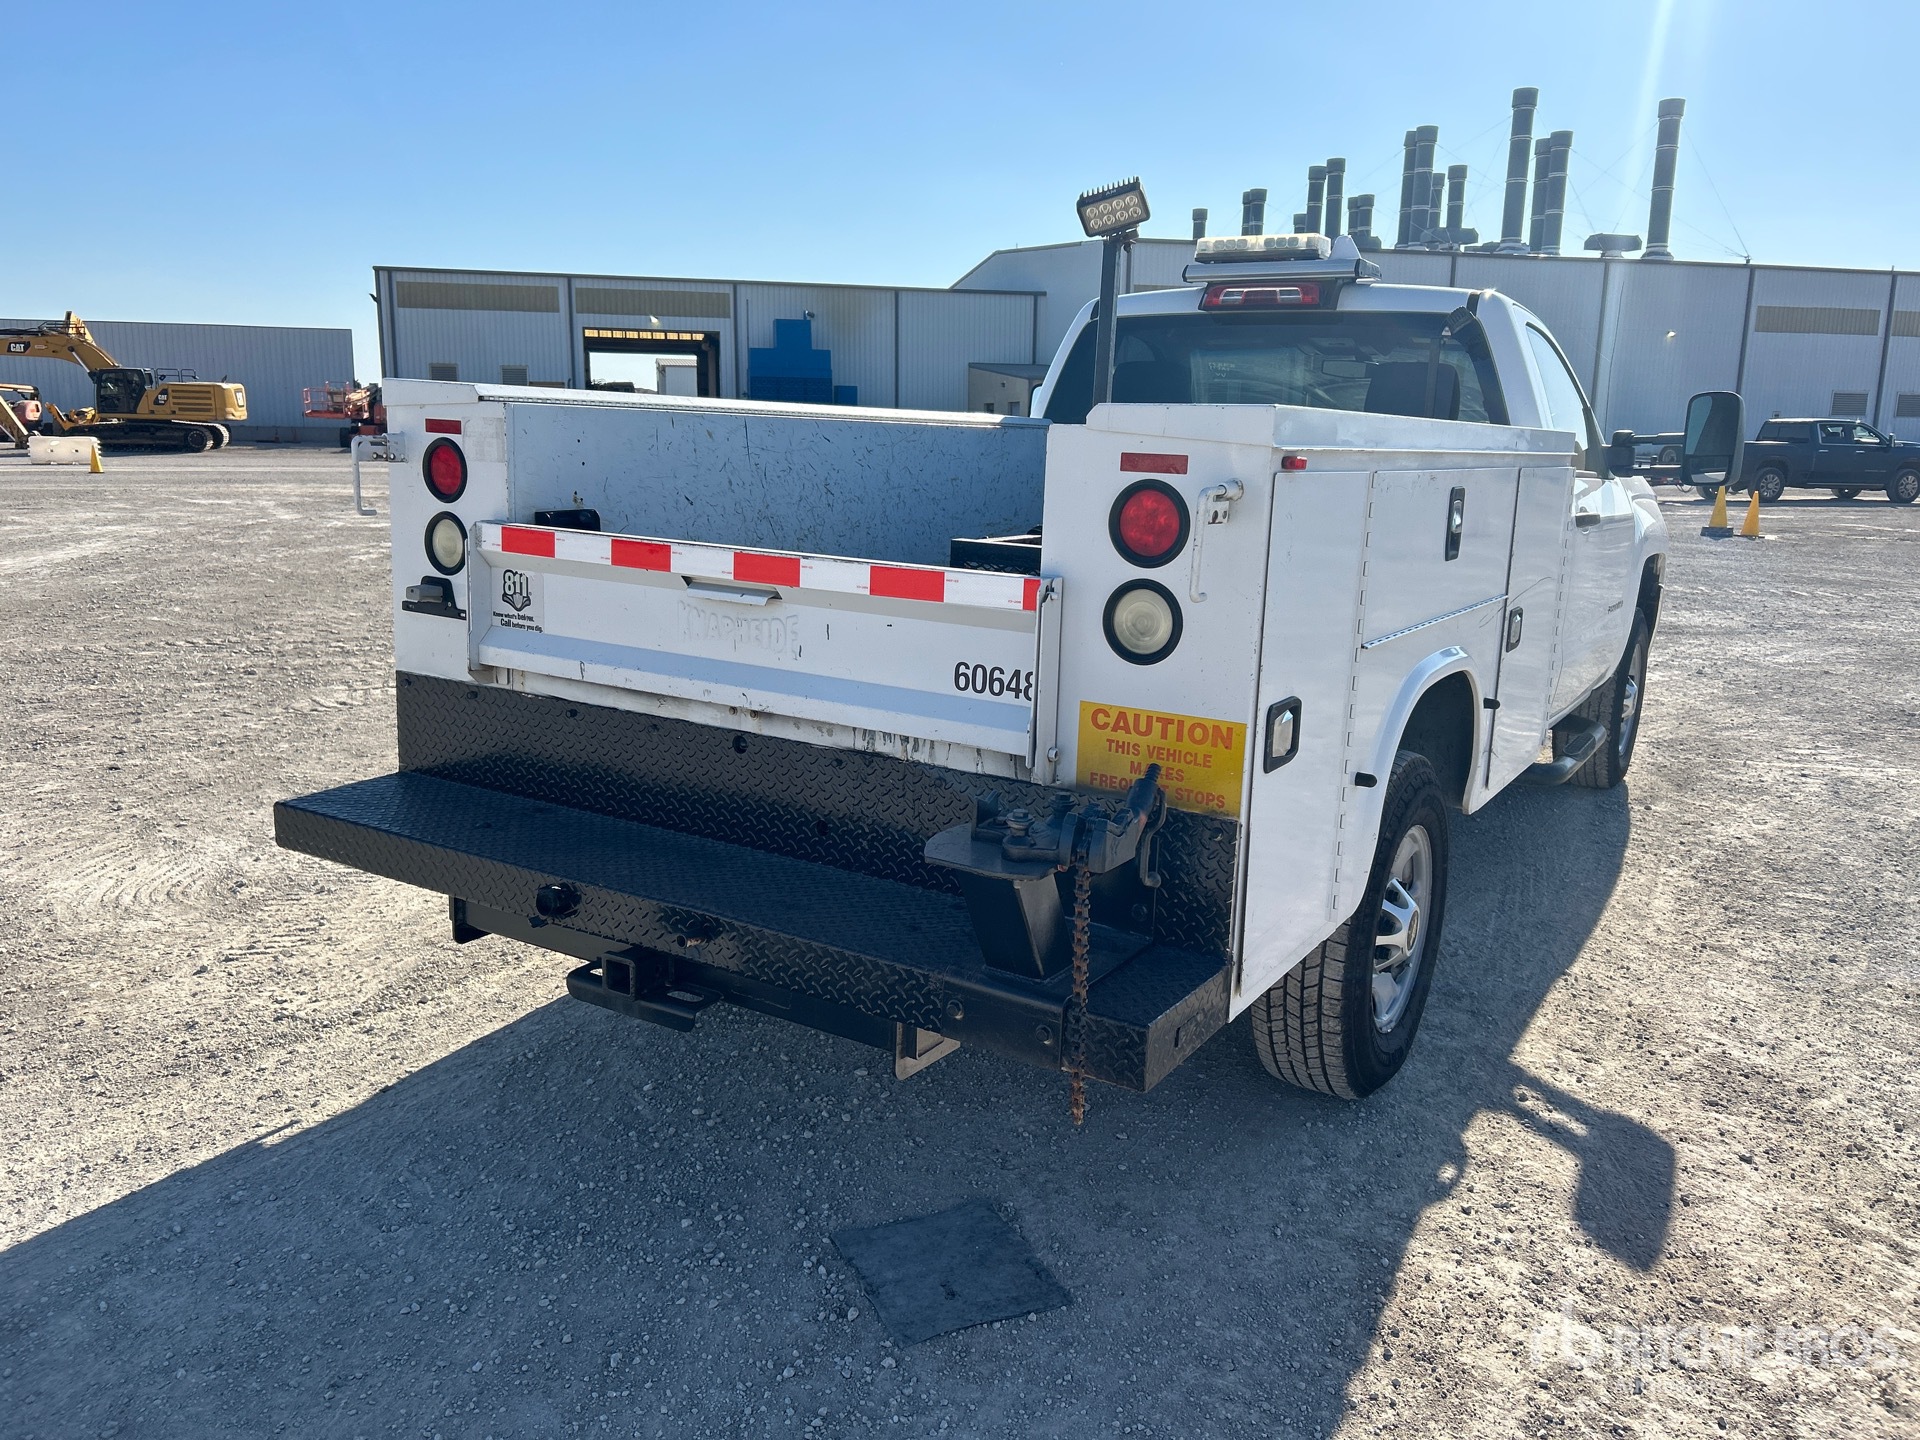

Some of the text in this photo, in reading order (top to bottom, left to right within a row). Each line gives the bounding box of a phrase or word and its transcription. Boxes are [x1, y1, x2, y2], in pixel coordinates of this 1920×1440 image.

[10, 343, 25, 352] CAT
[503, 569, 529, 597] 811
[501, 619, 511, 627] Call
[512, 621, 525, 629] before
[1090, 707, 1234, 751] CAUTION
[1106, 738, 1212, 769] THIS VEHICLE
[1129, 760, 1185, 783] MES
[1174, 787, 1226, 809] STOPS
